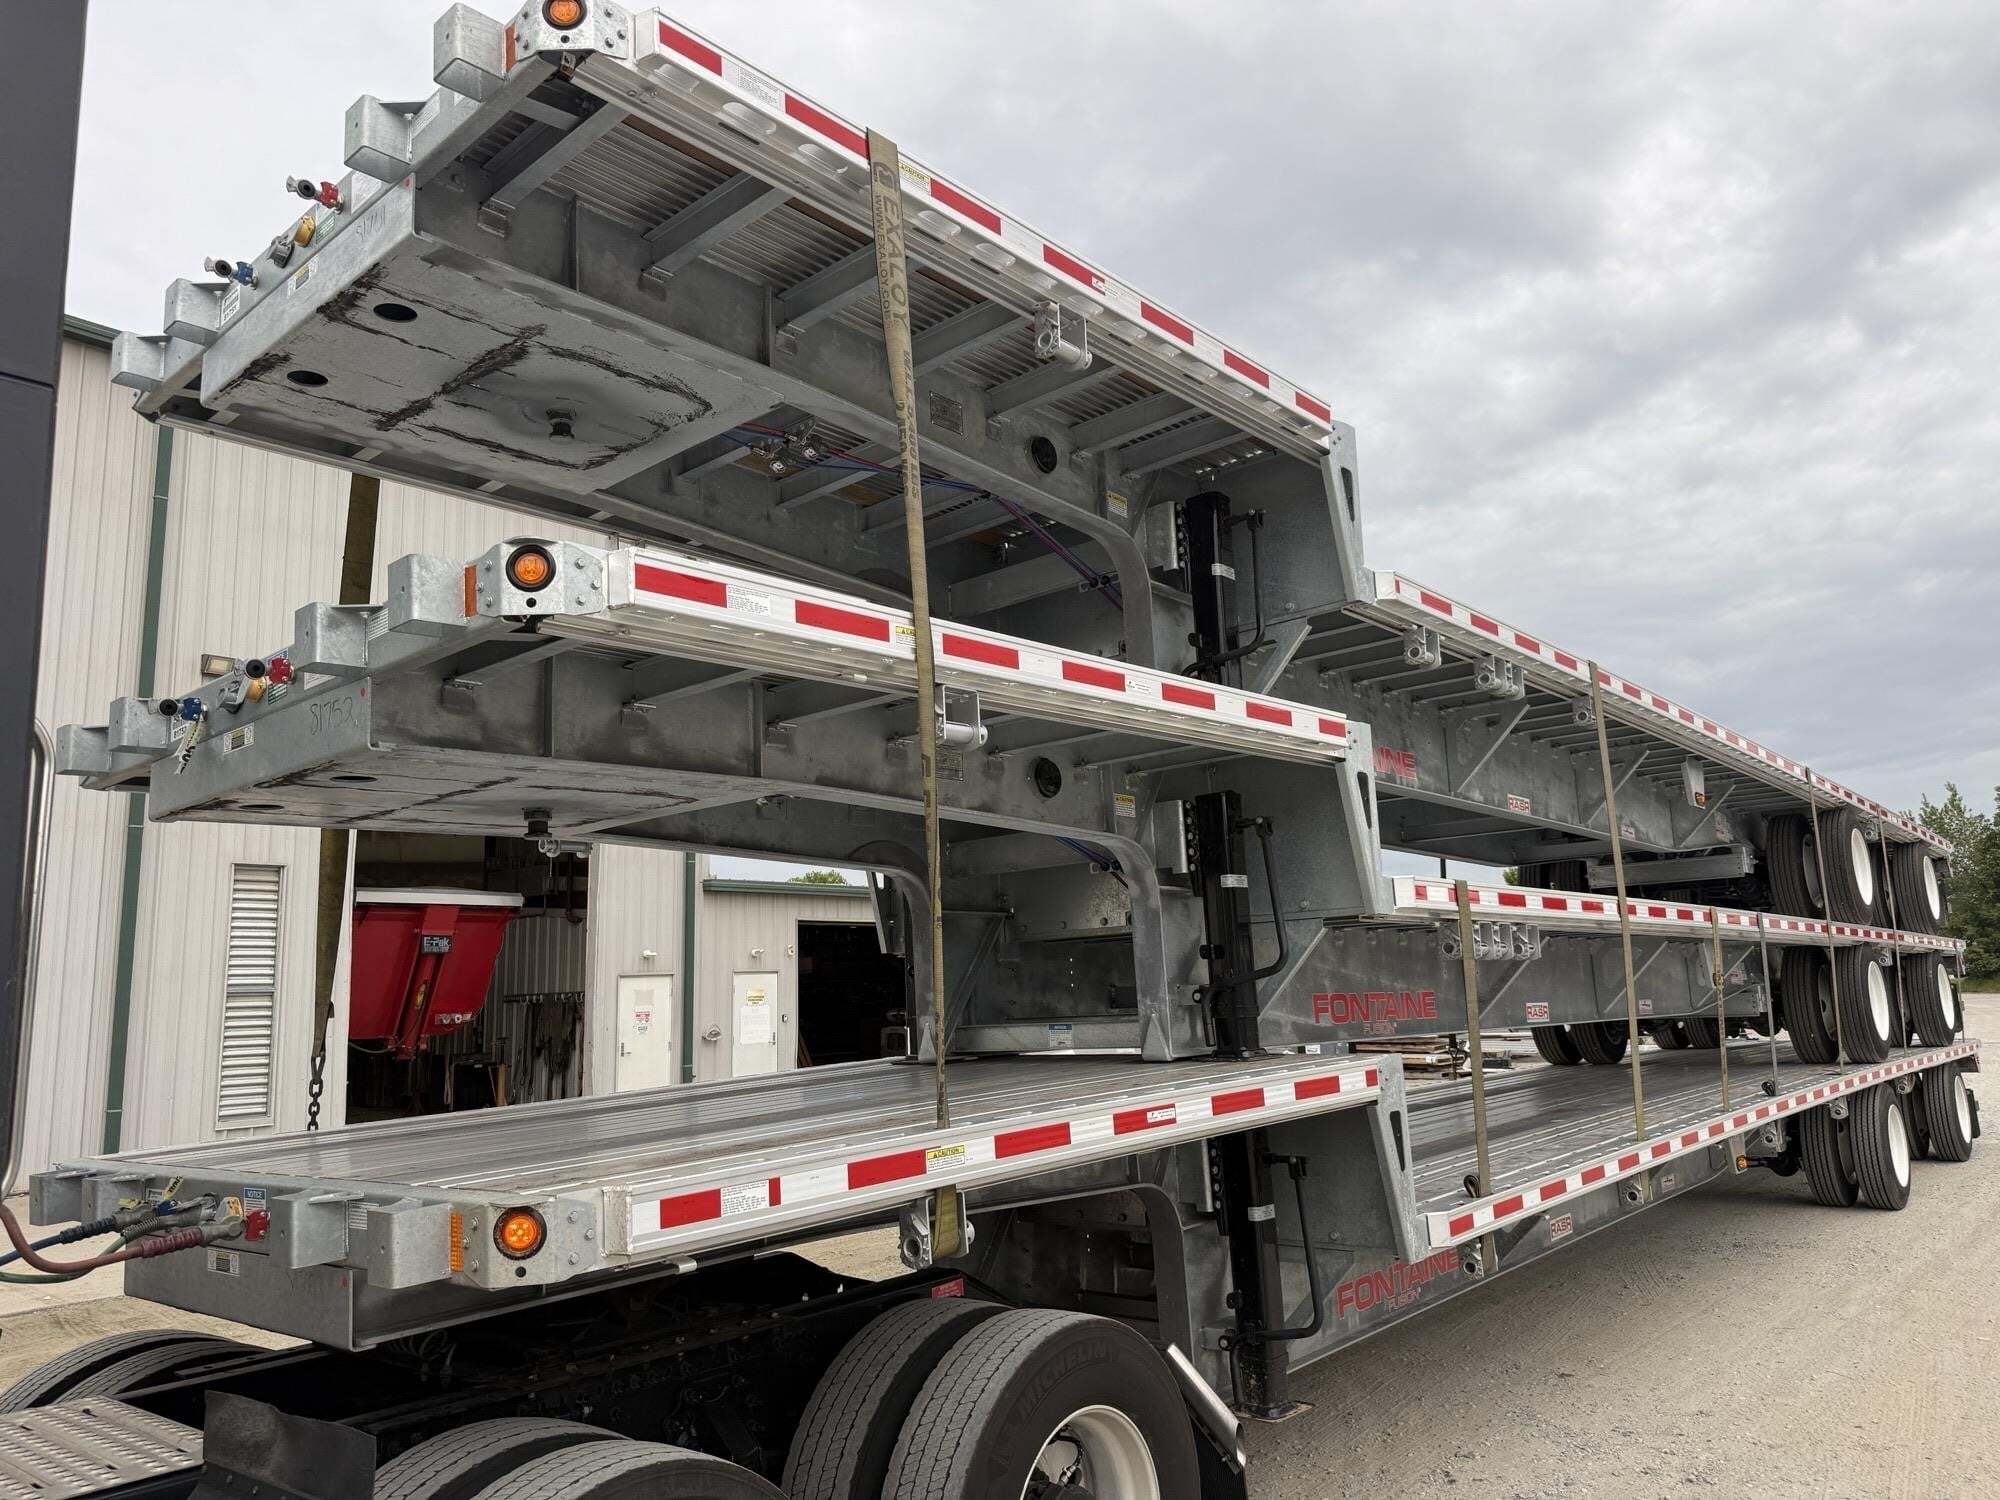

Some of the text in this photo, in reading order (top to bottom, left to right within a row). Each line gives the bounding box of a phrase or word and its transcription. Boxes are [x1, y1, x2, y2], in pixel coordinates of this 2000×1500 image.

[883, 195, 908, 331] EXALOY
[1312, 990, 1438, 1025] FONTAINE
[247, 1191, 263, 1199] NOTICE
[1335, 1247, 1462, 1320] FONTAINE
